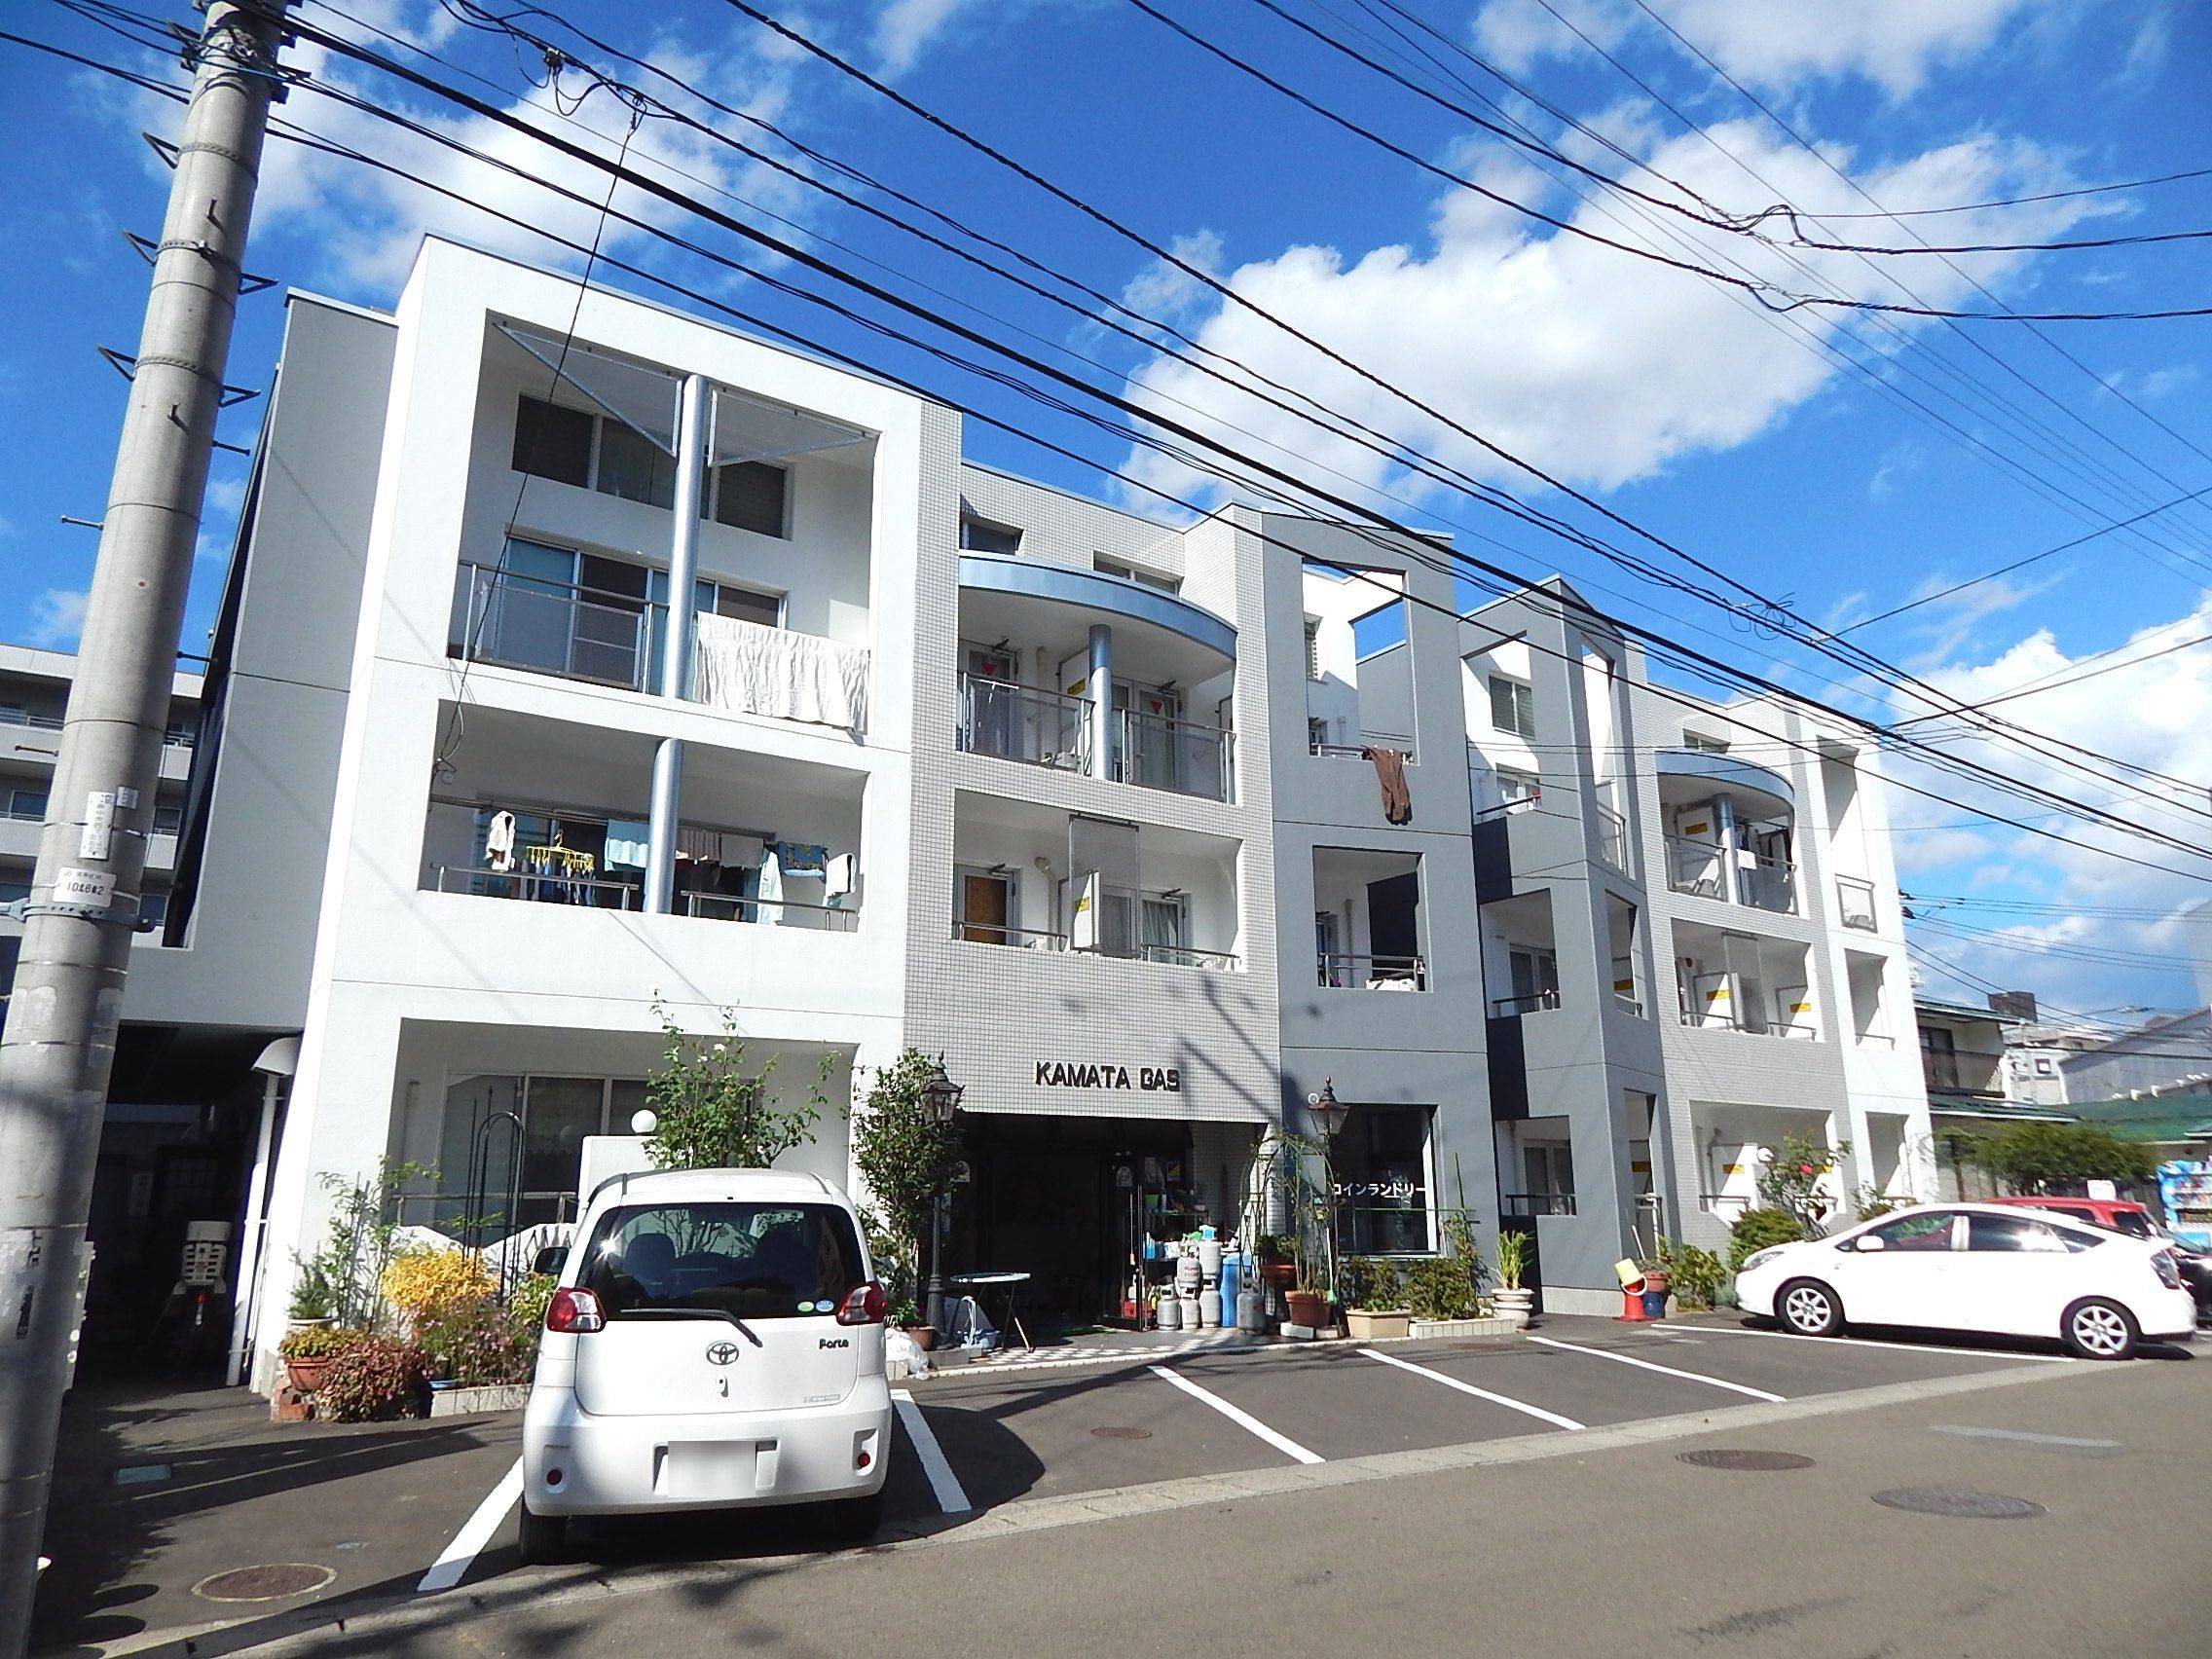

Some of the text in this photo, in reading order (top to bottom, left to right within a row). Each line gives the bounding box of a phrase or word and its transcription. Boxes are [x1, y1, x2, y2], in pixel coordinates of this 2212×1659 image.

[1035, 1061, 1181, 1091] KAMATA GAS
[1333, 1182, 1426, 1197] コインランドリー
[819, 1338, 850, 1349] Porte
